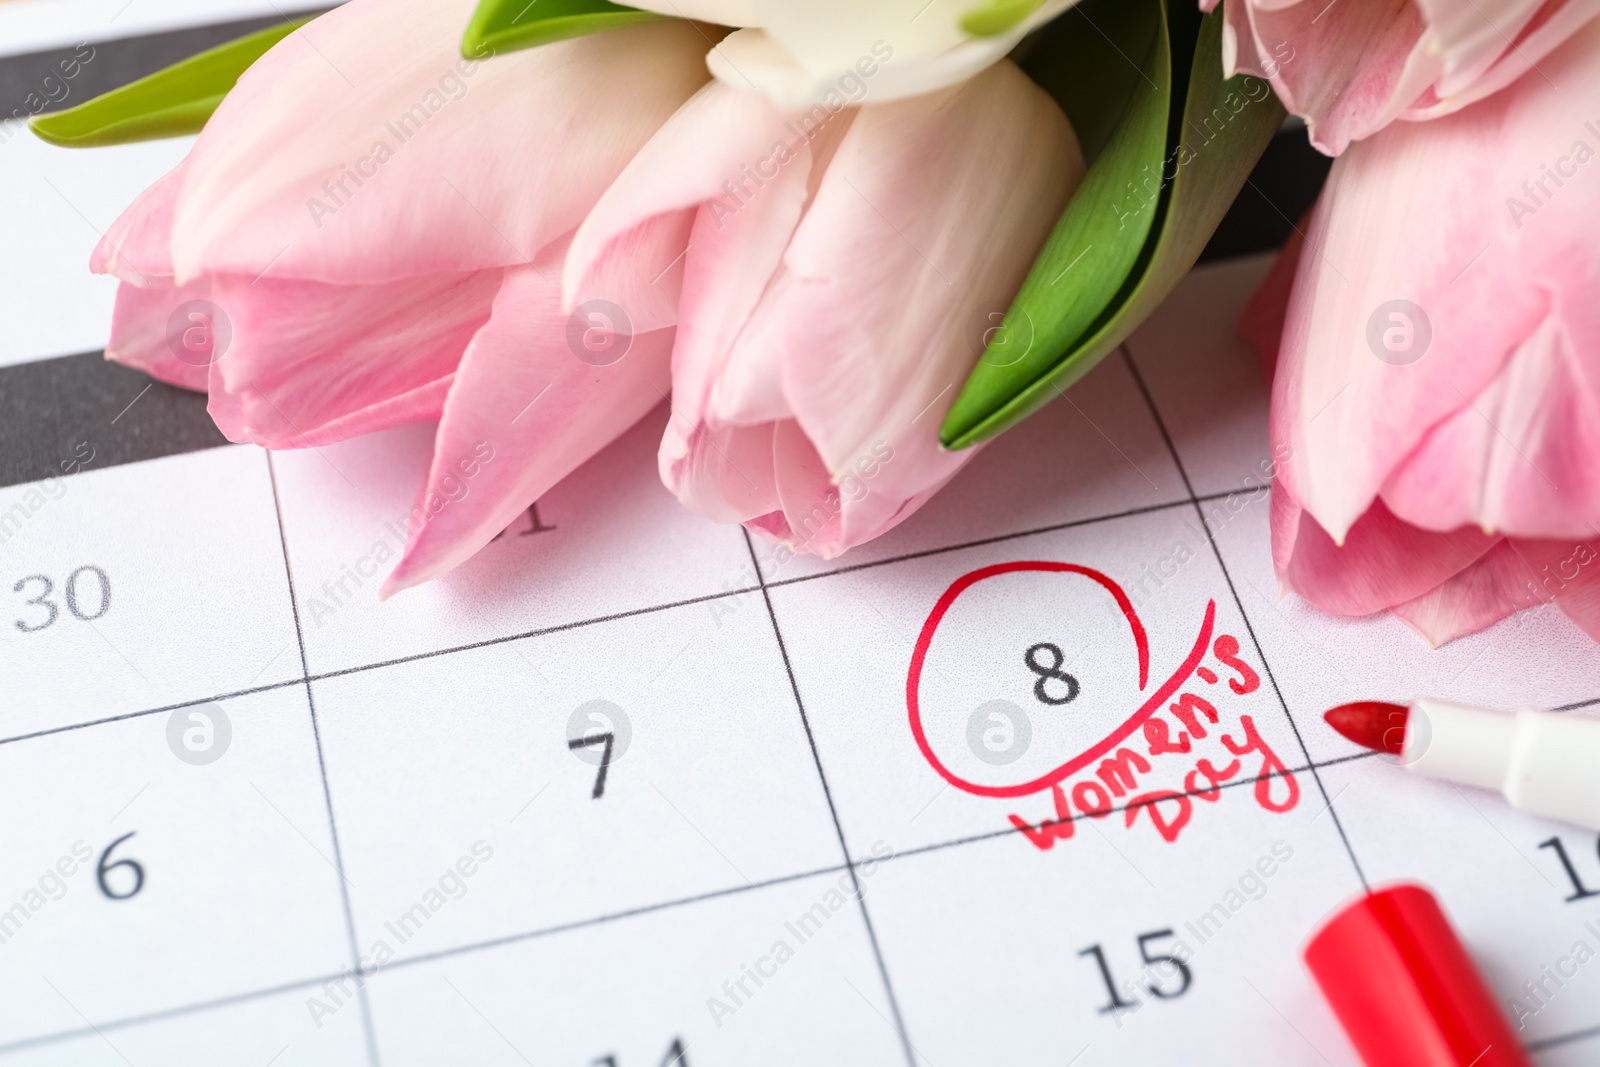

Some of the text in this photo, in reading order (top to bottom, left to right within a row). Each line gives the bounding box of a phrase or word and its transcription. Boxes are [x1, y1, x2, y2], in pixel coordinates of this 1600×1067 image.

[13, 564, 111, 633] 30
[1024, 642, 1081, 705] 8
[568, 732, 615, 800] 7
[1125, 714, 1300, 844] Day
[96, 830, 146, 901] 6
[1537, 834, 1600, 904] 1
[1077, 928, 1192, 1015] 15
